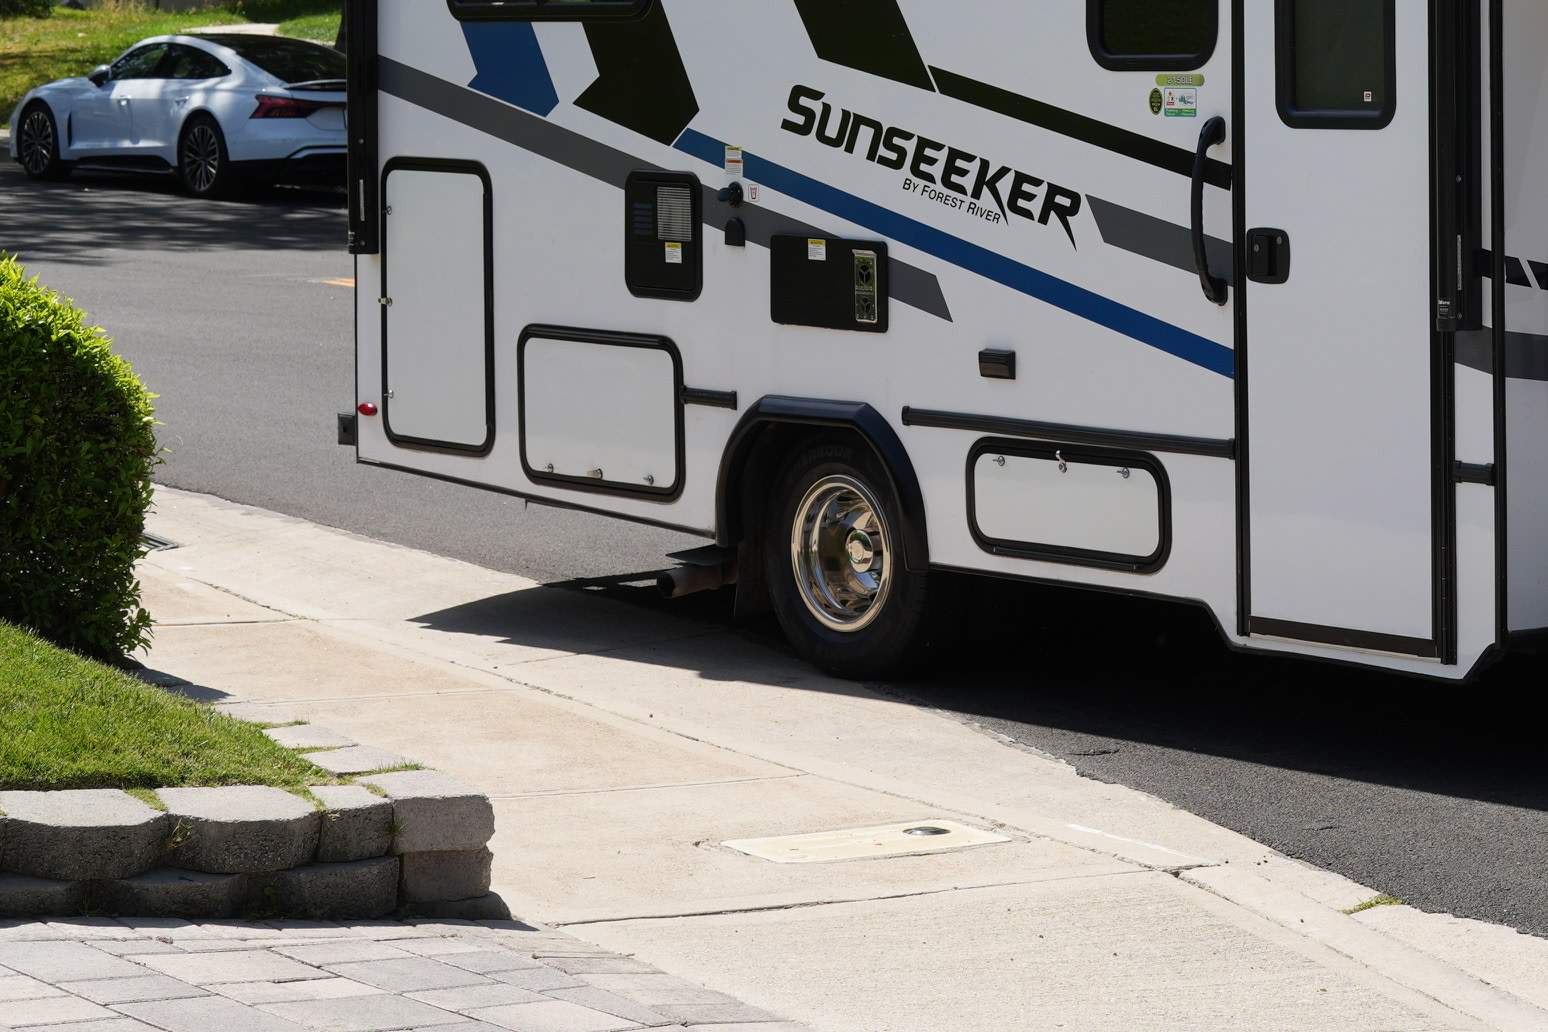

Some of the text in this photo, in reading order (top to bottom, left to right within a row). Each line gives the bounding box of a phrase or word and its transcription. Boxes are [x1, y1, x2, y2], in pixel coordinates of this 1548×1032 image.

[780, 84, 1081, 252] SUNSEEKER
[921, 184, 965, 209] FOREST
[966, 201, 1001, 224] RIVER
